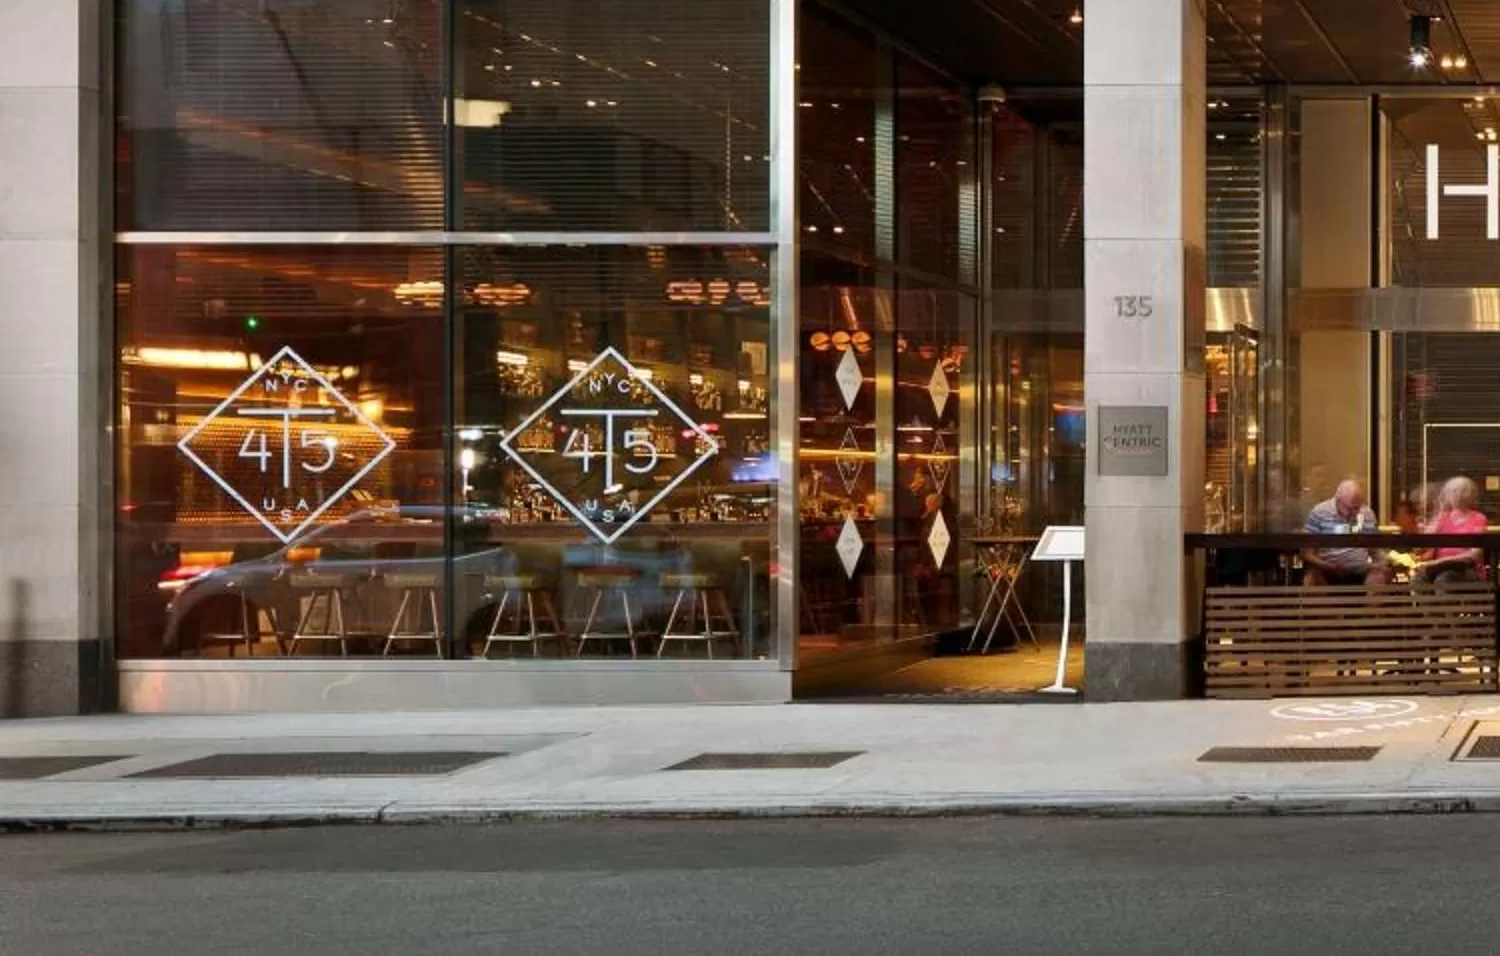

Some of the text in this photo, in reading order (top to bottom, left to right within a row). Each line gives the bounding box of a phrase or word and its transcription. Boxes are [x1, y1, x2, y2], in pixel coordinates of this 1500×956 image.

[1114, 295, 1153, 317] 135
[265, 371, 308, 392] NYC
[589, 371, 631, 393] NYC
[1112, 424, 1153, 435] HYATT
[263, 497, 309, 522] USA
[586, 499, 633, 523] USA
